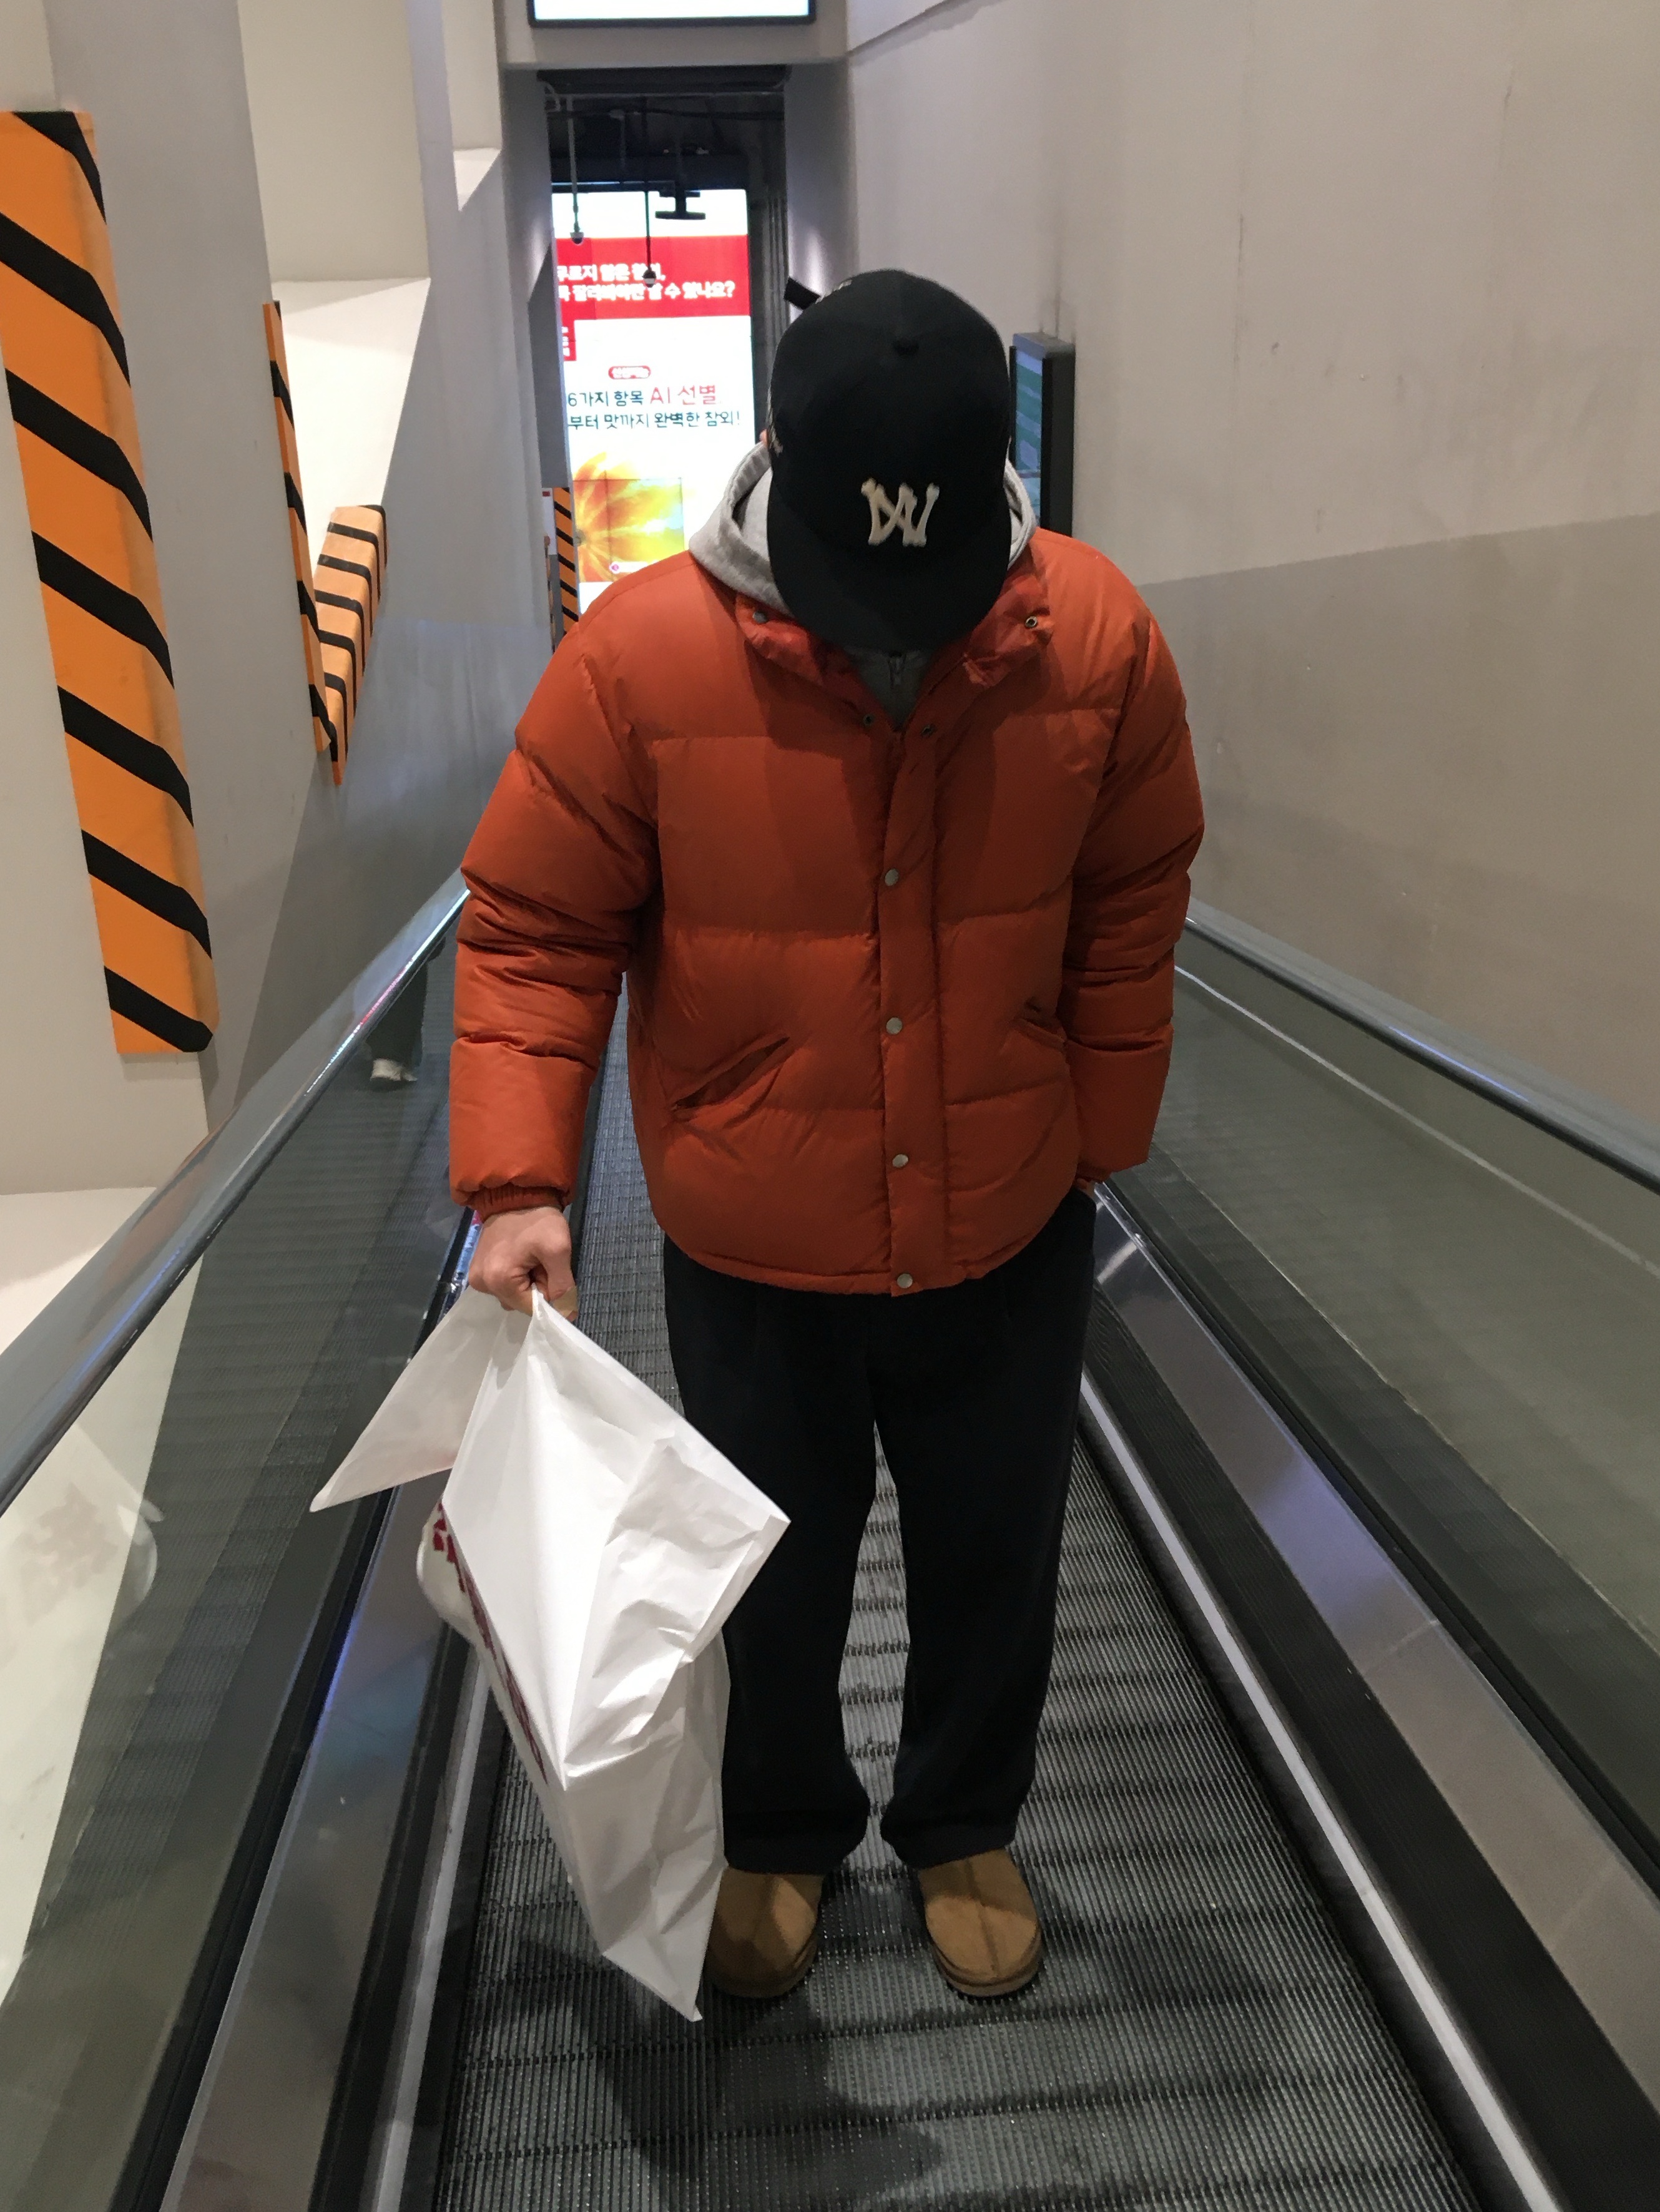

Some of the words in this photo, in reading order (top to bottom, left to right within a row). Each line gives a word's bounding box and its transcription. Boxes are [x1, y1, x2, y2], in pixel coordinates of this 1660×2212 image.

[664, 283, 681, 298] 수
[682, 280, 735, 298] 있나요?
[567, 391, 609, 407] 6가지
[614, 389, 644, 406] 항목
[650, 387, 670, 404] AI
[677, 384, 716, 405] 선별
[569, 416, 599, 429] 부터
[604, 413, 649, 429] 맛까지
[654, 411, 700, 428] 완벽한
[705, 410, 740, 427] 참외!
